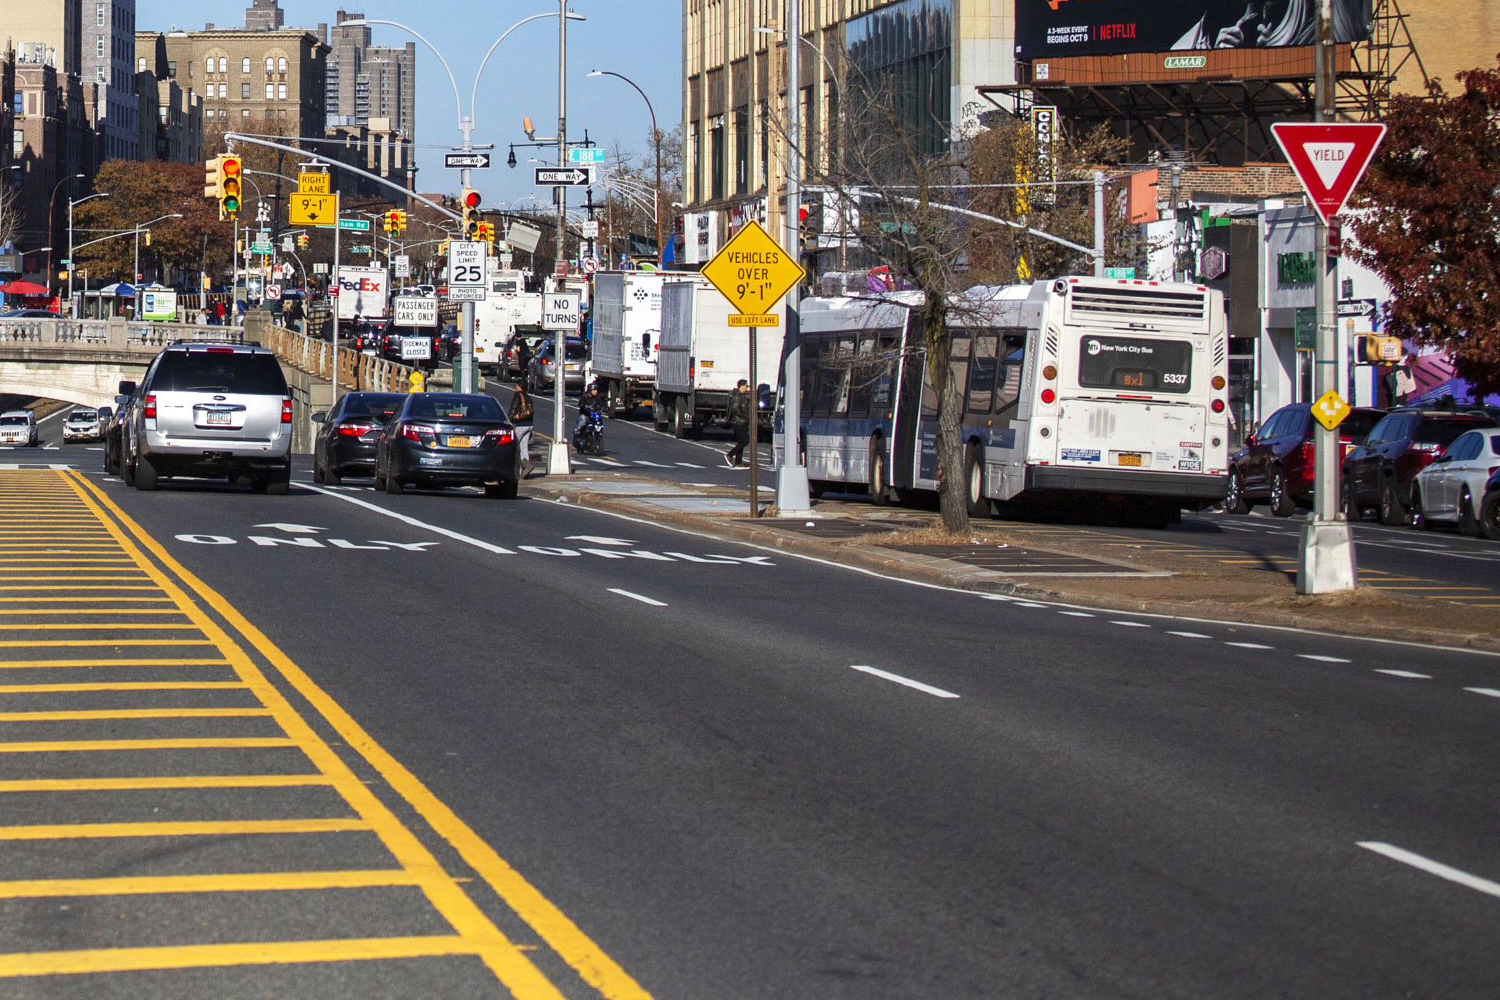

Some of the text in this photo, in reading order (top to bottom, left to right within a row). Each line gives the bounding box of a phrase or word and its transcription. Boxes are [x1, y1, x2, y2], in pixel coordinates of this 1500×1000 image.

[1072, 25, 1088, 33] EVENT
[1100, 23, 1136, 40] NETFLIX
[1047, 33, 1088, 43] BEGINS OCT 9
[1167, 58, 1202, 66] LAMAR
[569, 151, 575, 160] E
[579, 151, 593, 160] 188
[1314, 150, 1344, 161] YIELD
[302, 176, 326, 184] RIGHT
[728, 252, 778, 263] VEHICLES
[454, 266, 481, 281] 25
[738, 268, 768, 279] OVER
[1107, 270, 1112, 278] E
[1114, 269, 1126, 277] 188
[338, 278, 380, 292] FedEx
[398, 301, 434, 310] PASSENGER
[554, 300, 569, 309] NO
[398, 311, 434, 320] CARS ONLY
[546, 314, 577, 323] TURNS
[1128, 345, 1141, 353] City
[1124, 372, 1144, 386] Bx1
[1163, 373, 1187, 384] 5337
[174, 534, 441, 552] ONLY
[517, 545, 776, 567] ONLY
